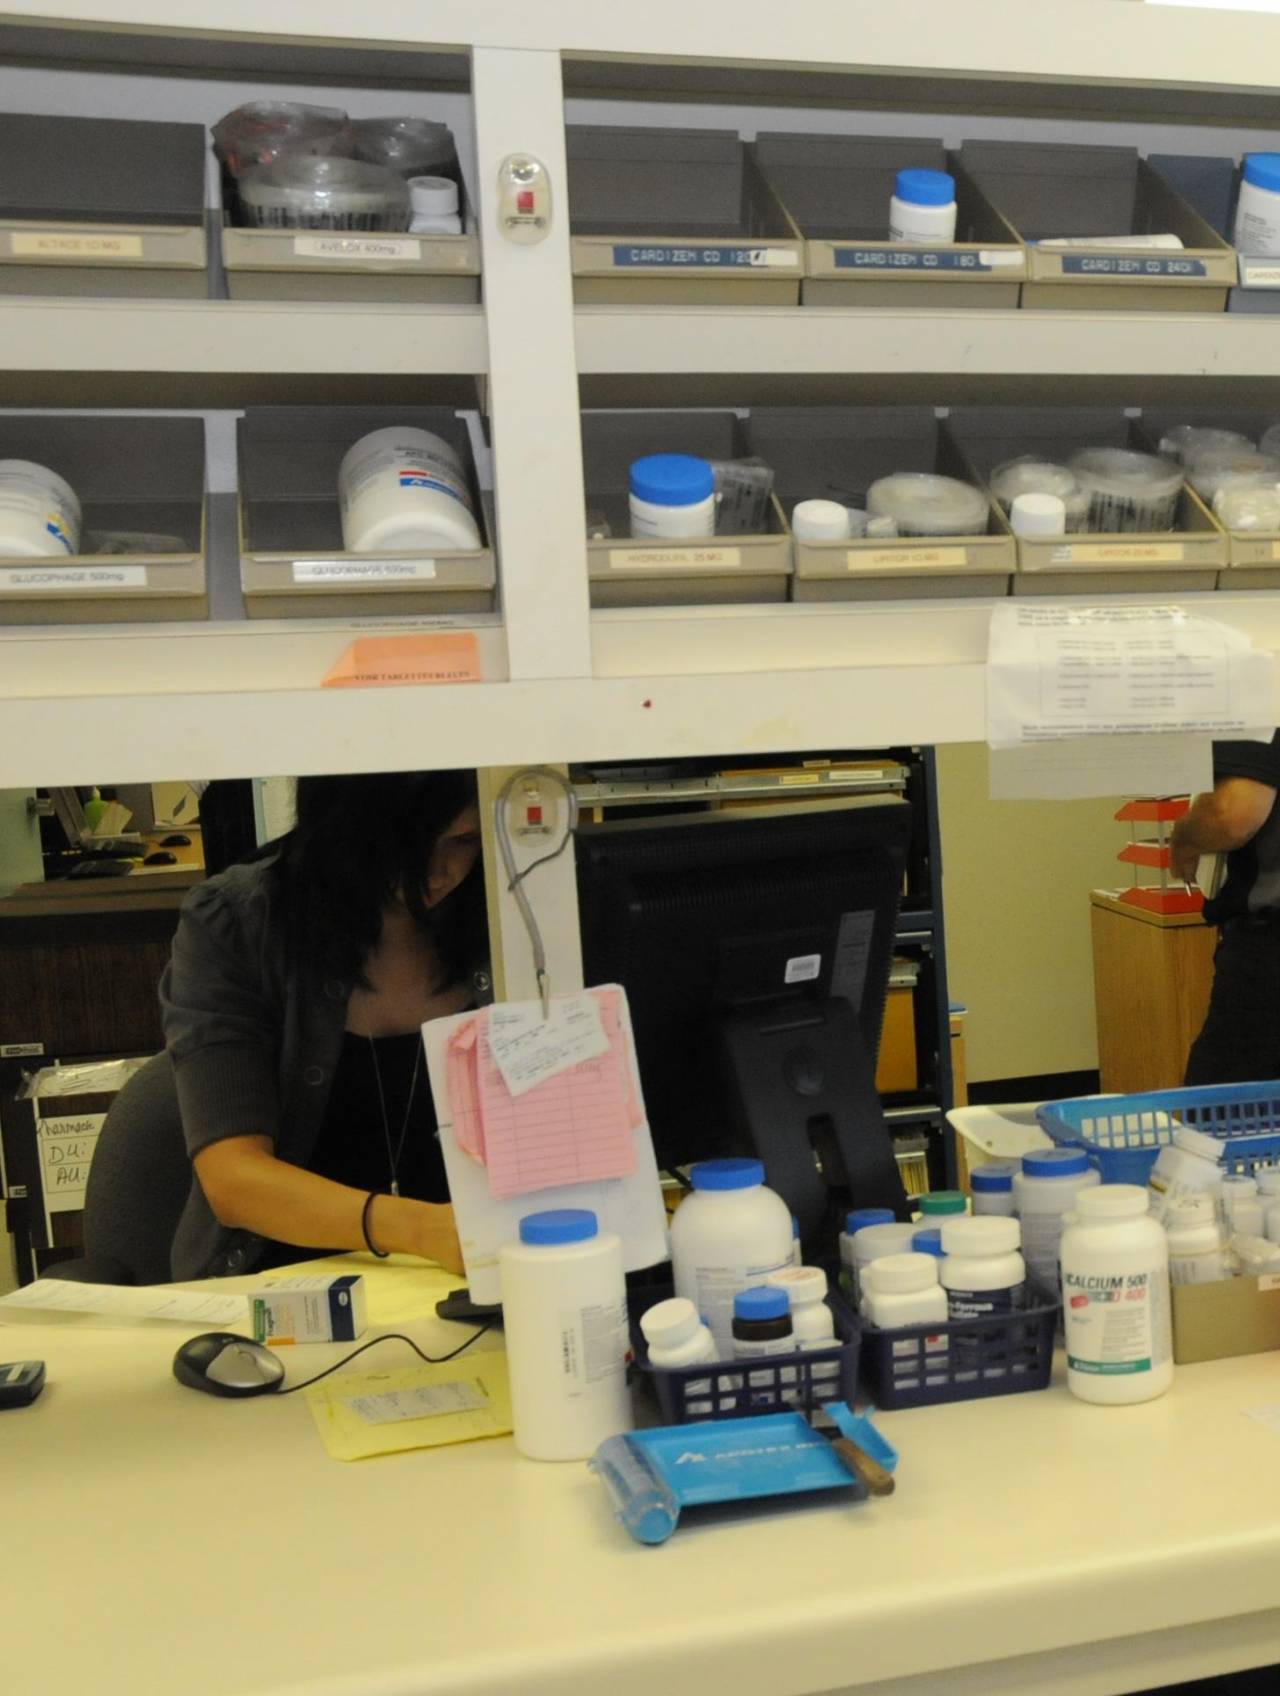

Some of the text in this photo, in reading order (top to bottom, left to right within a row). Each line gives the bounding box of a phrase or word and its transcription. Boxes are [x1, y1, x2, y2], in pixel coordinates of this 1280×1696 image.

[629, 249, 698, 263] CARDIZEM
[702, 250, 721, 263] CD
[853, 252, 917, 266] CARDIZEM
[922, 254, 939, 267] CD
[1080, 259, 1141, 272] CARDIZEM
[1145, 260, 1161, 274] CD
[10, 571, 86, 584] GLUCOPHAGE
[1127, 1272, 1148, 1288] 500
